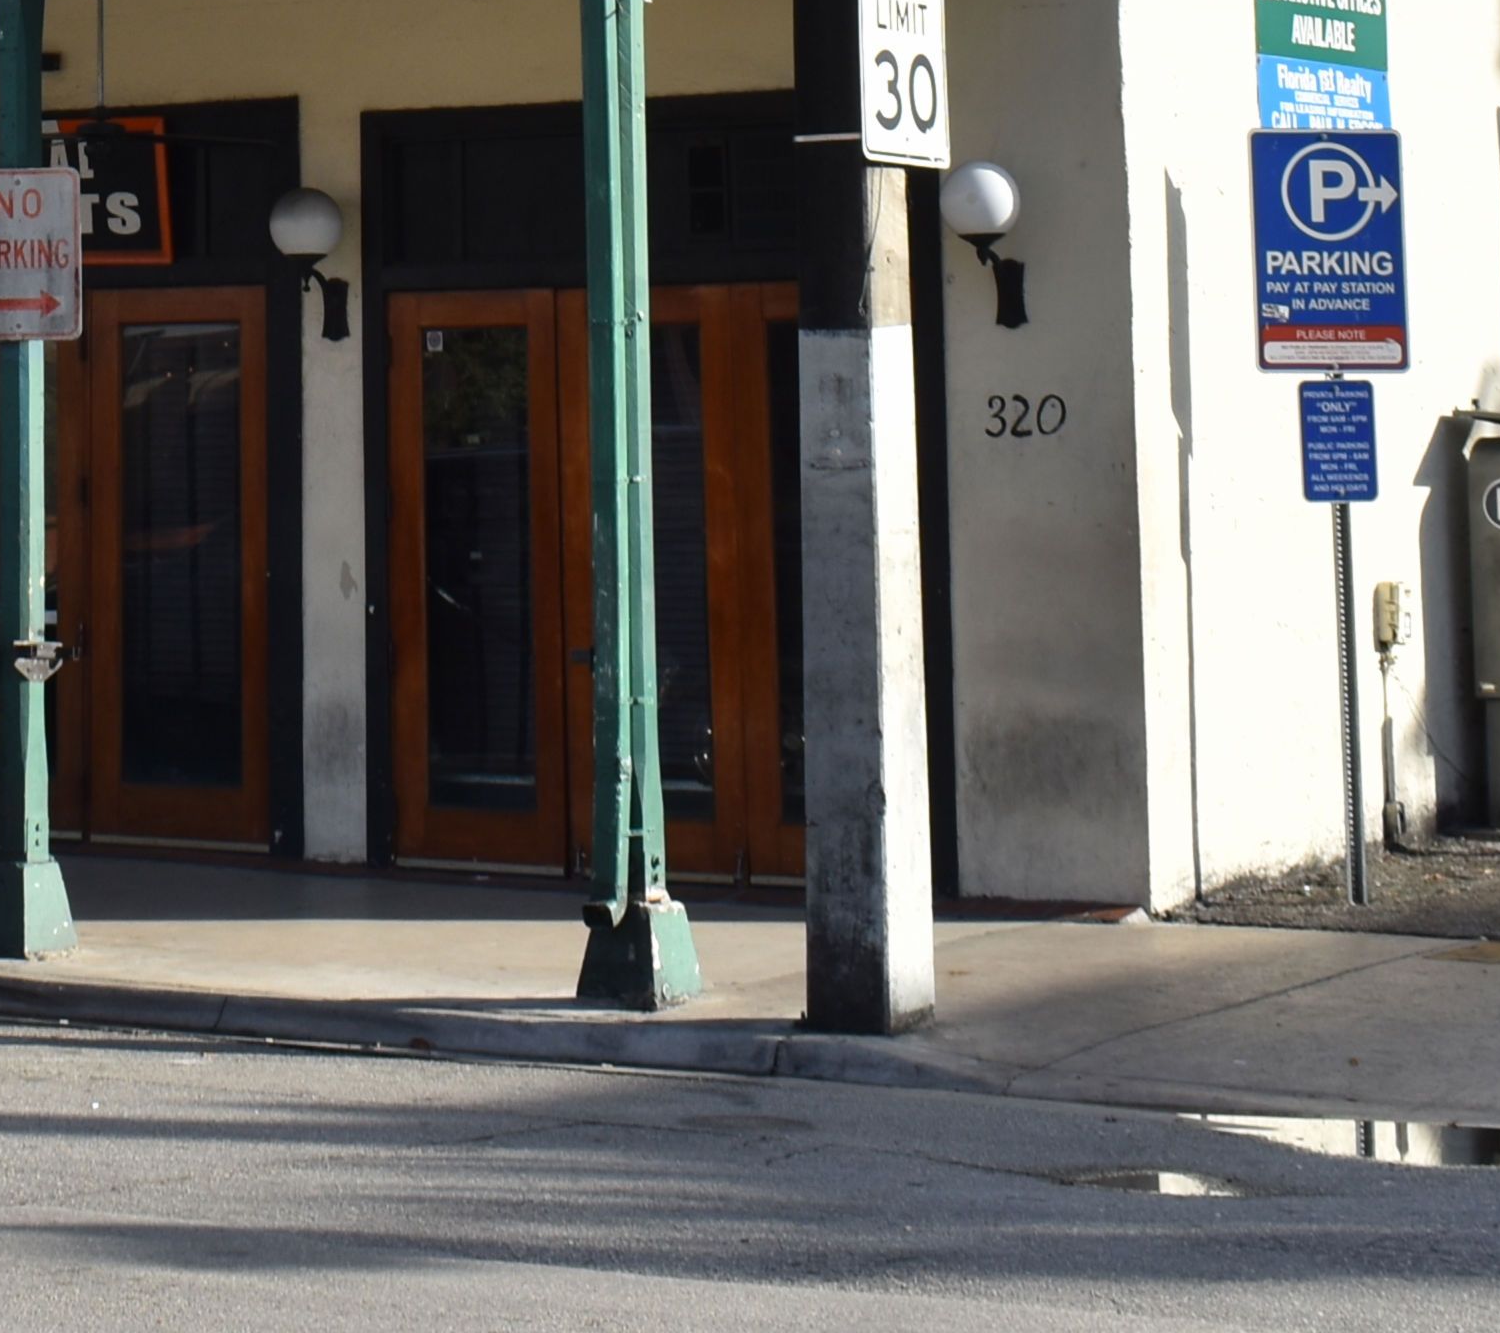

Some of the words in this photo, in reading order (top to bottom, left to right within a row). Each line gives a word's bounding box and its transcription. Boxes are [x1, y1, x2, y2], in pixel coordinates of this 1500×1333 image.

[1291, 14, 1356, 52] AVAILABLE
[874, 48, 937, 133] 30
[1276, 63, 1317, 92] Florida
[1335, 70, 1372, 104] Realty
[1266, 250, 1394, 277] PARKING
[1266, 281, 1290, 294] PAY
[1293, 281, 1310, 294] AT
[1313, 281, 1338, 294] PAY
[1341, 281, 1396, 295] STATION
[1291, 298, 1306, 310] IN
[1308, 298, 1371, 311] ADVANCE
[1295, 329, 1335, 340] PLEASE
[1337, 329, 1367, 340] NOTE
[985, 393, 1067, 438] 320
